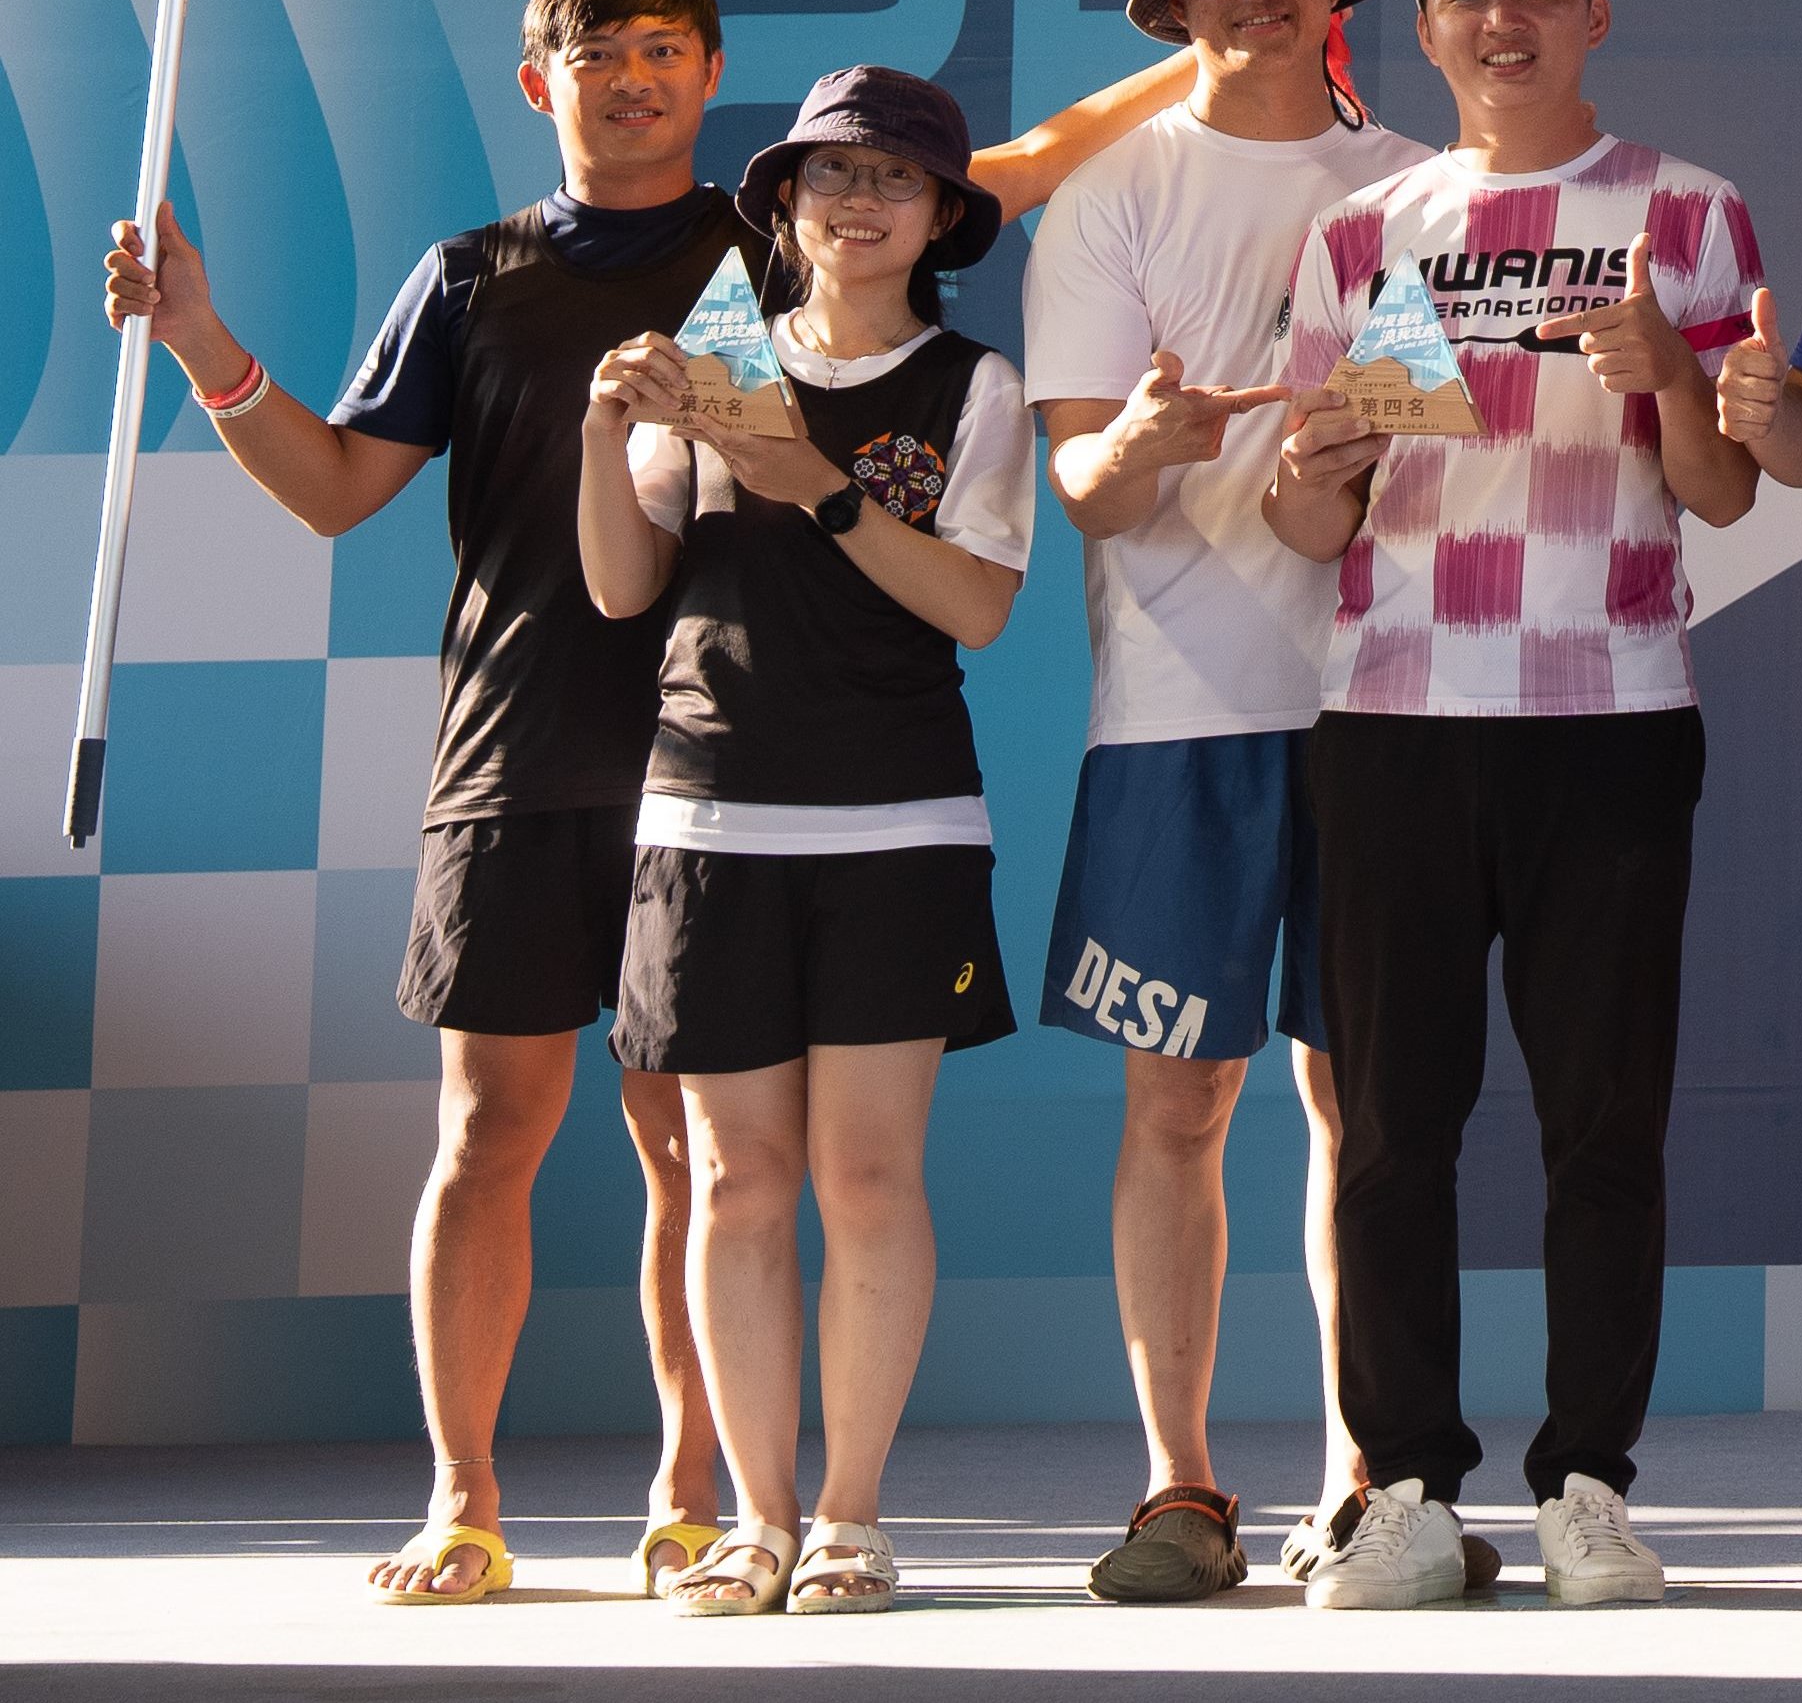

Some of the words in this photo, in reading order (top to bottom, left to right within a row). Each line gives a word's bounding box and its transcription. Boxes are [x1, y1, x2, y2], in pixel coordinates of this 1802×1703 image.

[678, 393, 744, 418] 第六名
[1359, 397, 1426, 418] 第四名
